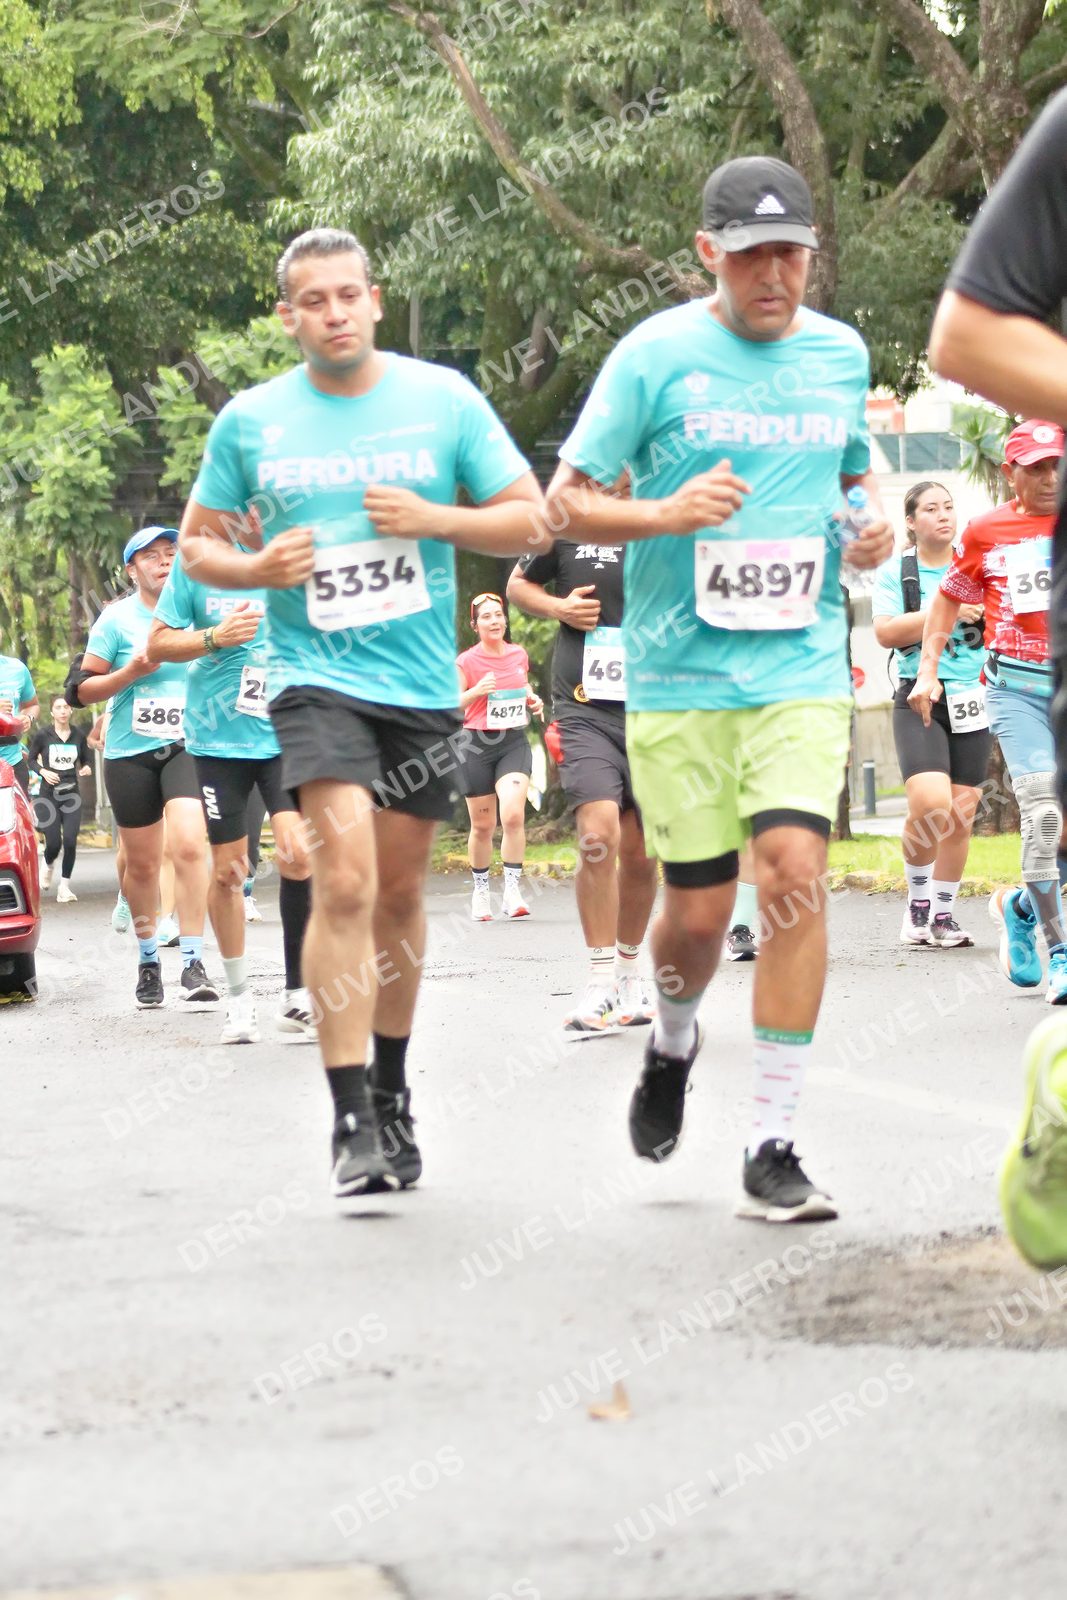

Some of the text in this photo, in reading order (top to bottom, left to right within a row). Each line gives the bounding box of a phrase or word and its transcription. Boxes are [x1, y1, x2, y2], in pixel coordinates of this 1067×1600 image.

[257, 448, 438, 490] PERDURA
[312, 555, 416, 601] 5334
[706, 560, 816, 599] 4897
[1016, 570, 1052, 595] 36
[588, 659, 623, 682] 46
[137, 707, 185, 726] 386
[490, 704, 523, 719] 4872
